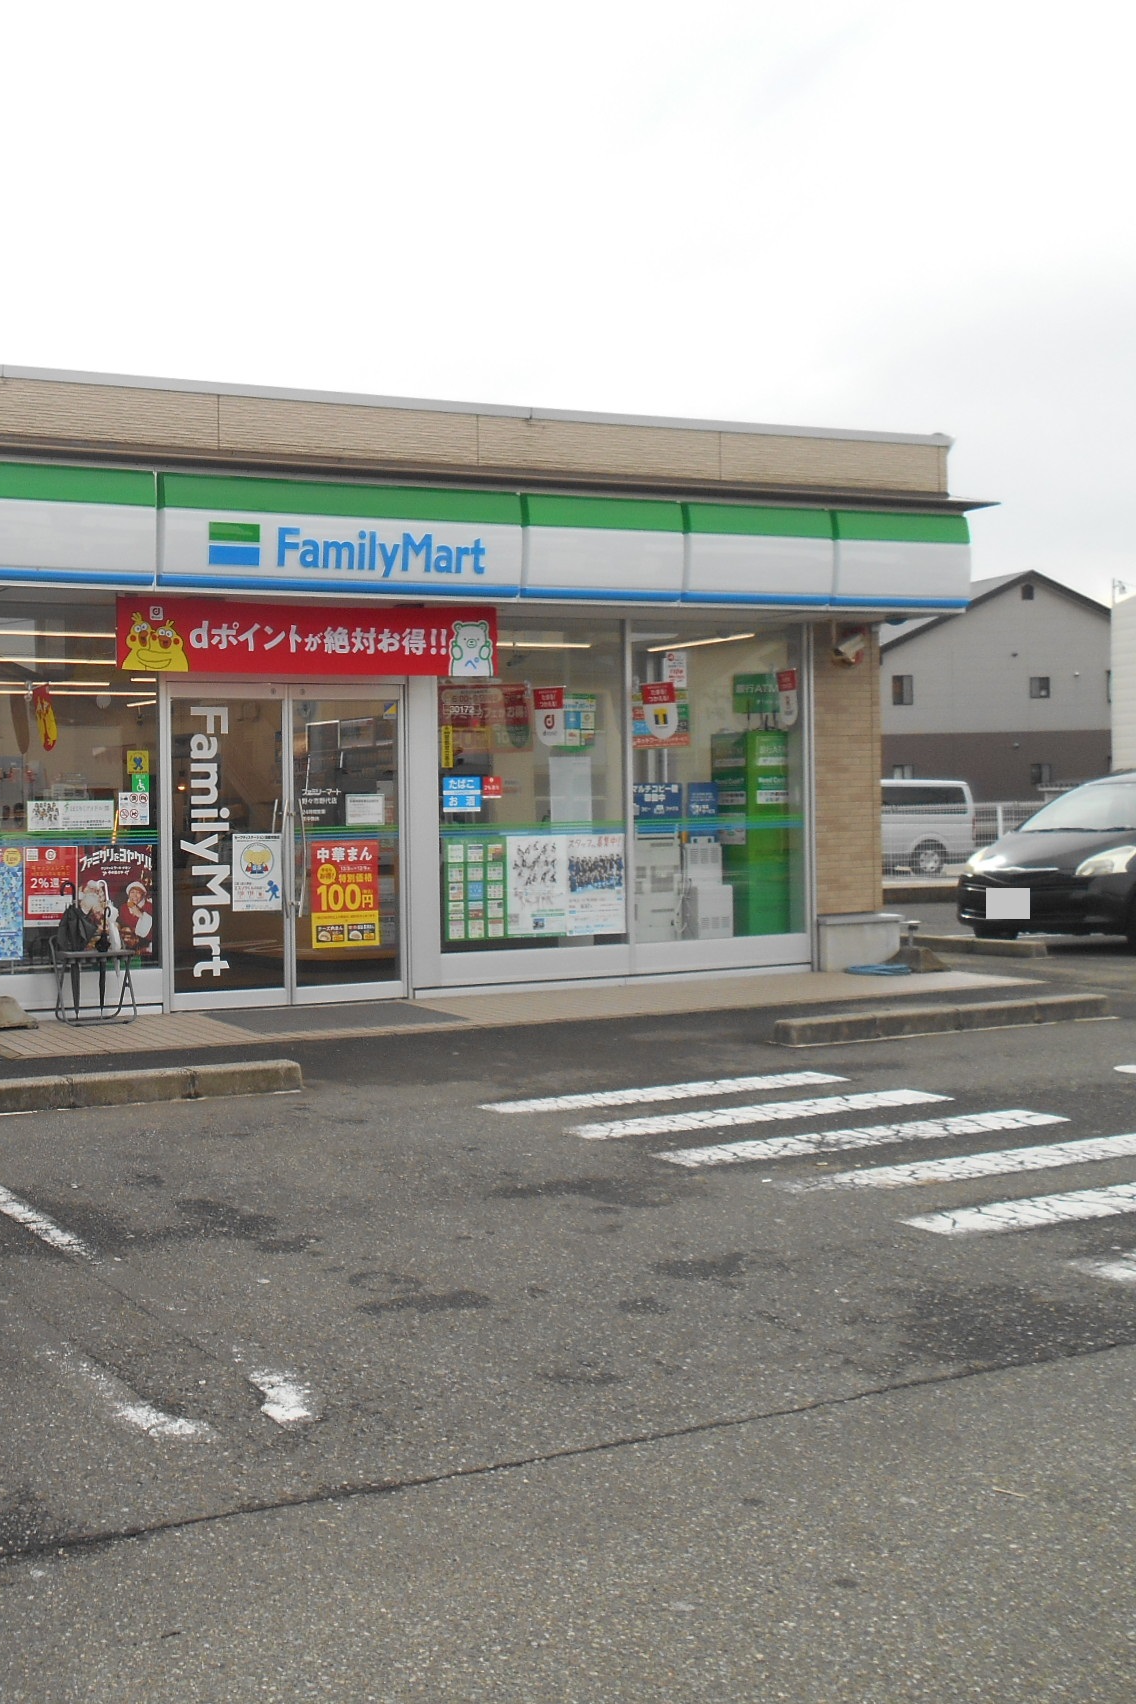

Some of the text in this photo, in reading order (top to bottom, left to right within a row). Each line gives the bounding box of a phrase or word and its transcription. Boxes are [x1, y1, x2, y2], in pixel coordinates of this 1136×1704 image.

[277, 526, 486, 577] FamilyMart
[189, 620, 448, 656] dポイントが絶対お得!!
[449, 779, 475, 790] たばこ
[179, 706, 231, 979] FamilyMart
[317, 846, 373, 863] 中華まん
[317, 883, 374, 911] 100 円
